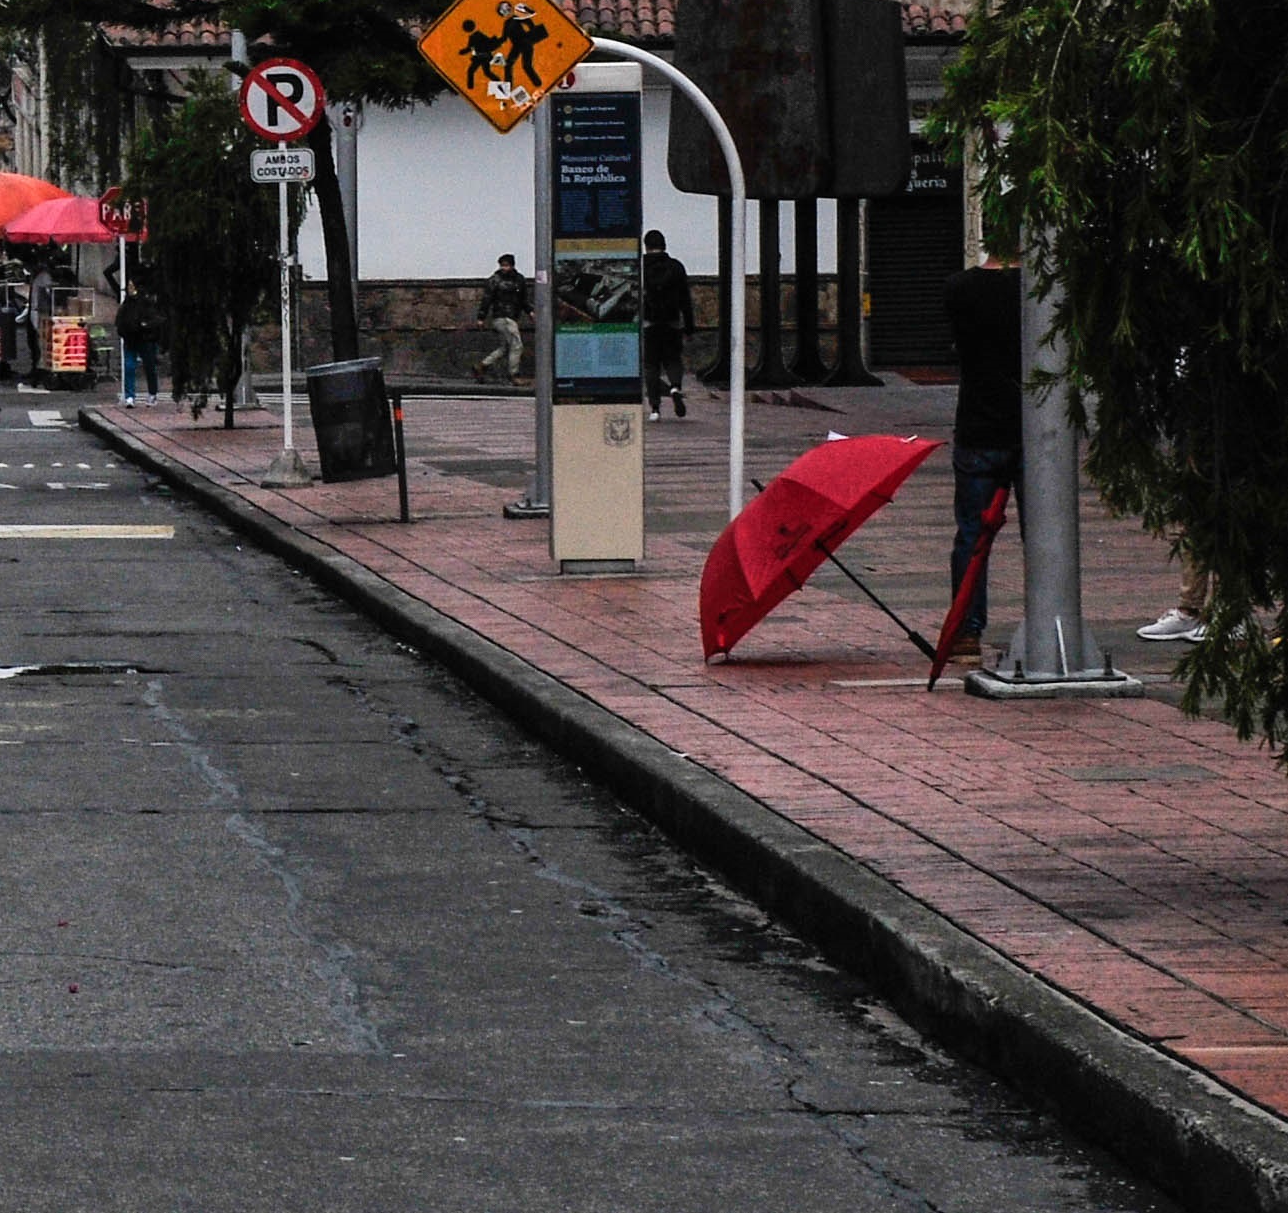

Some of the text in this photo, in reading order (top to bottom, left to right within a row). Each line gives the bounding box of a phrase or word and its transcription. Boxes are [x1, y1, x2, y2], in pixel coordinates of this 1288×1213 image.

[266, 73, 304, 126] P
[265, 154, 300, 165] AMBOS
[257, 166, 309, 177] COSTADOS
[560, 164, 609, 173] Banco de
[560, 173, 627, 185] la República
